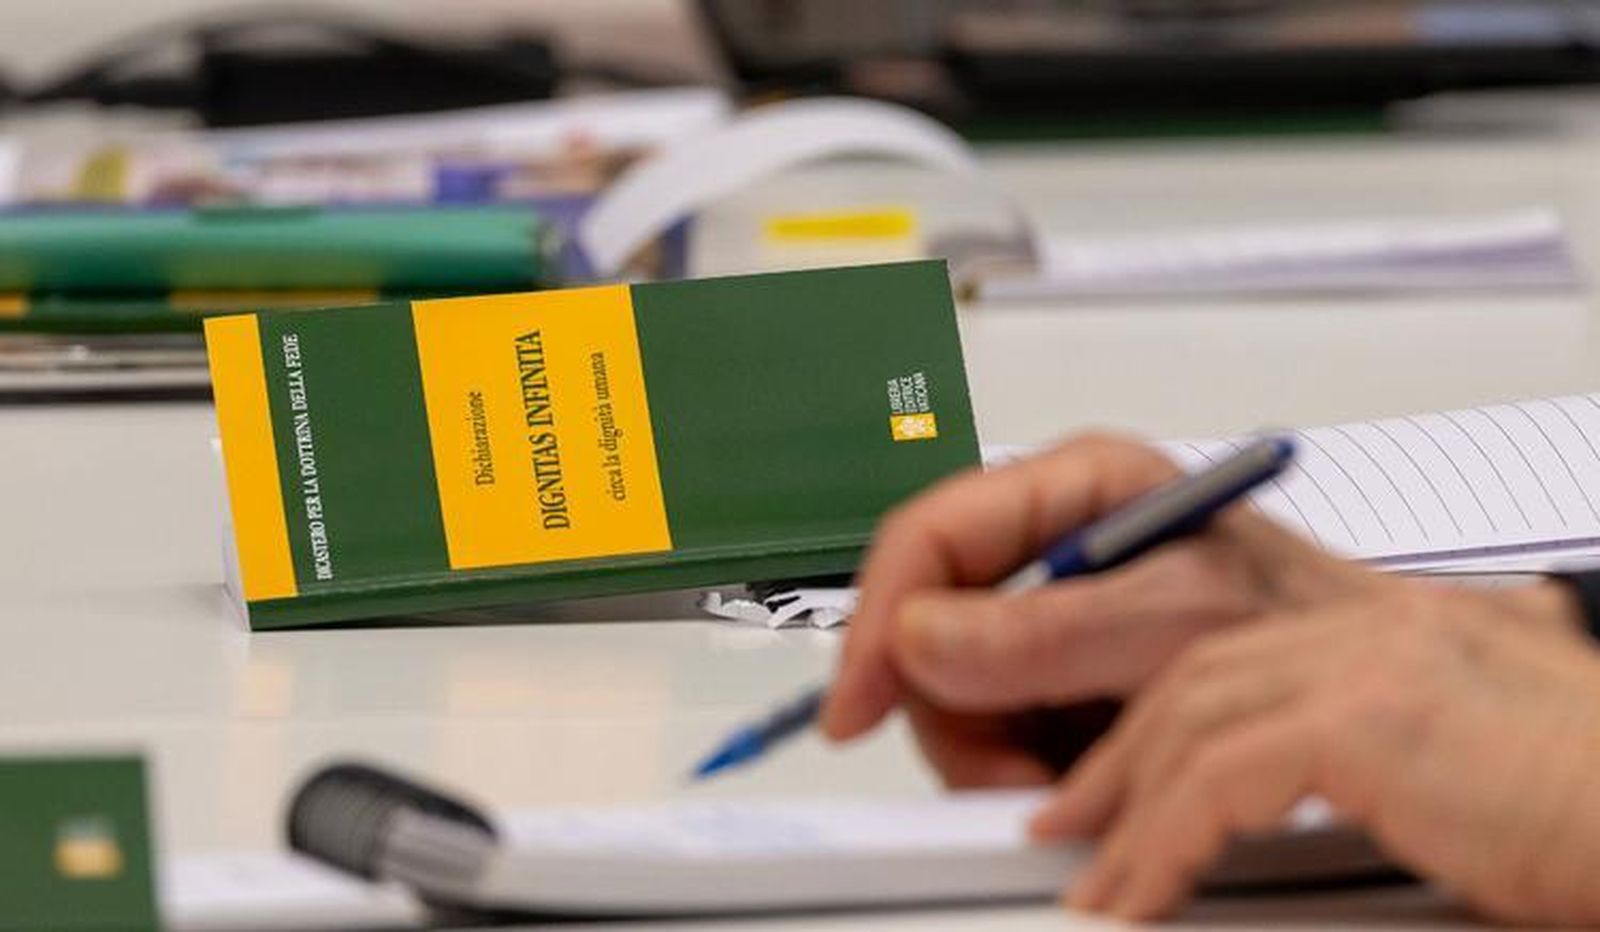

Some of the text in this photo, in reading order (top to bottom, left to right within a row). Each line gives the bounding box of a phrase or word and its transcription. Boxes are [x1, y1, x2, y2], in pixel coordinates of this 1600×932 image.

[282, 333, 333, 580] DICASTERO PER LA DOTTRINA DELLA FEDE
[465, 391, 496, 487] Dichiarazione
[514, 328, 571, 530] DIGNITAS INFINITA
[590, 351, 627, 502] circa la dignità umana
